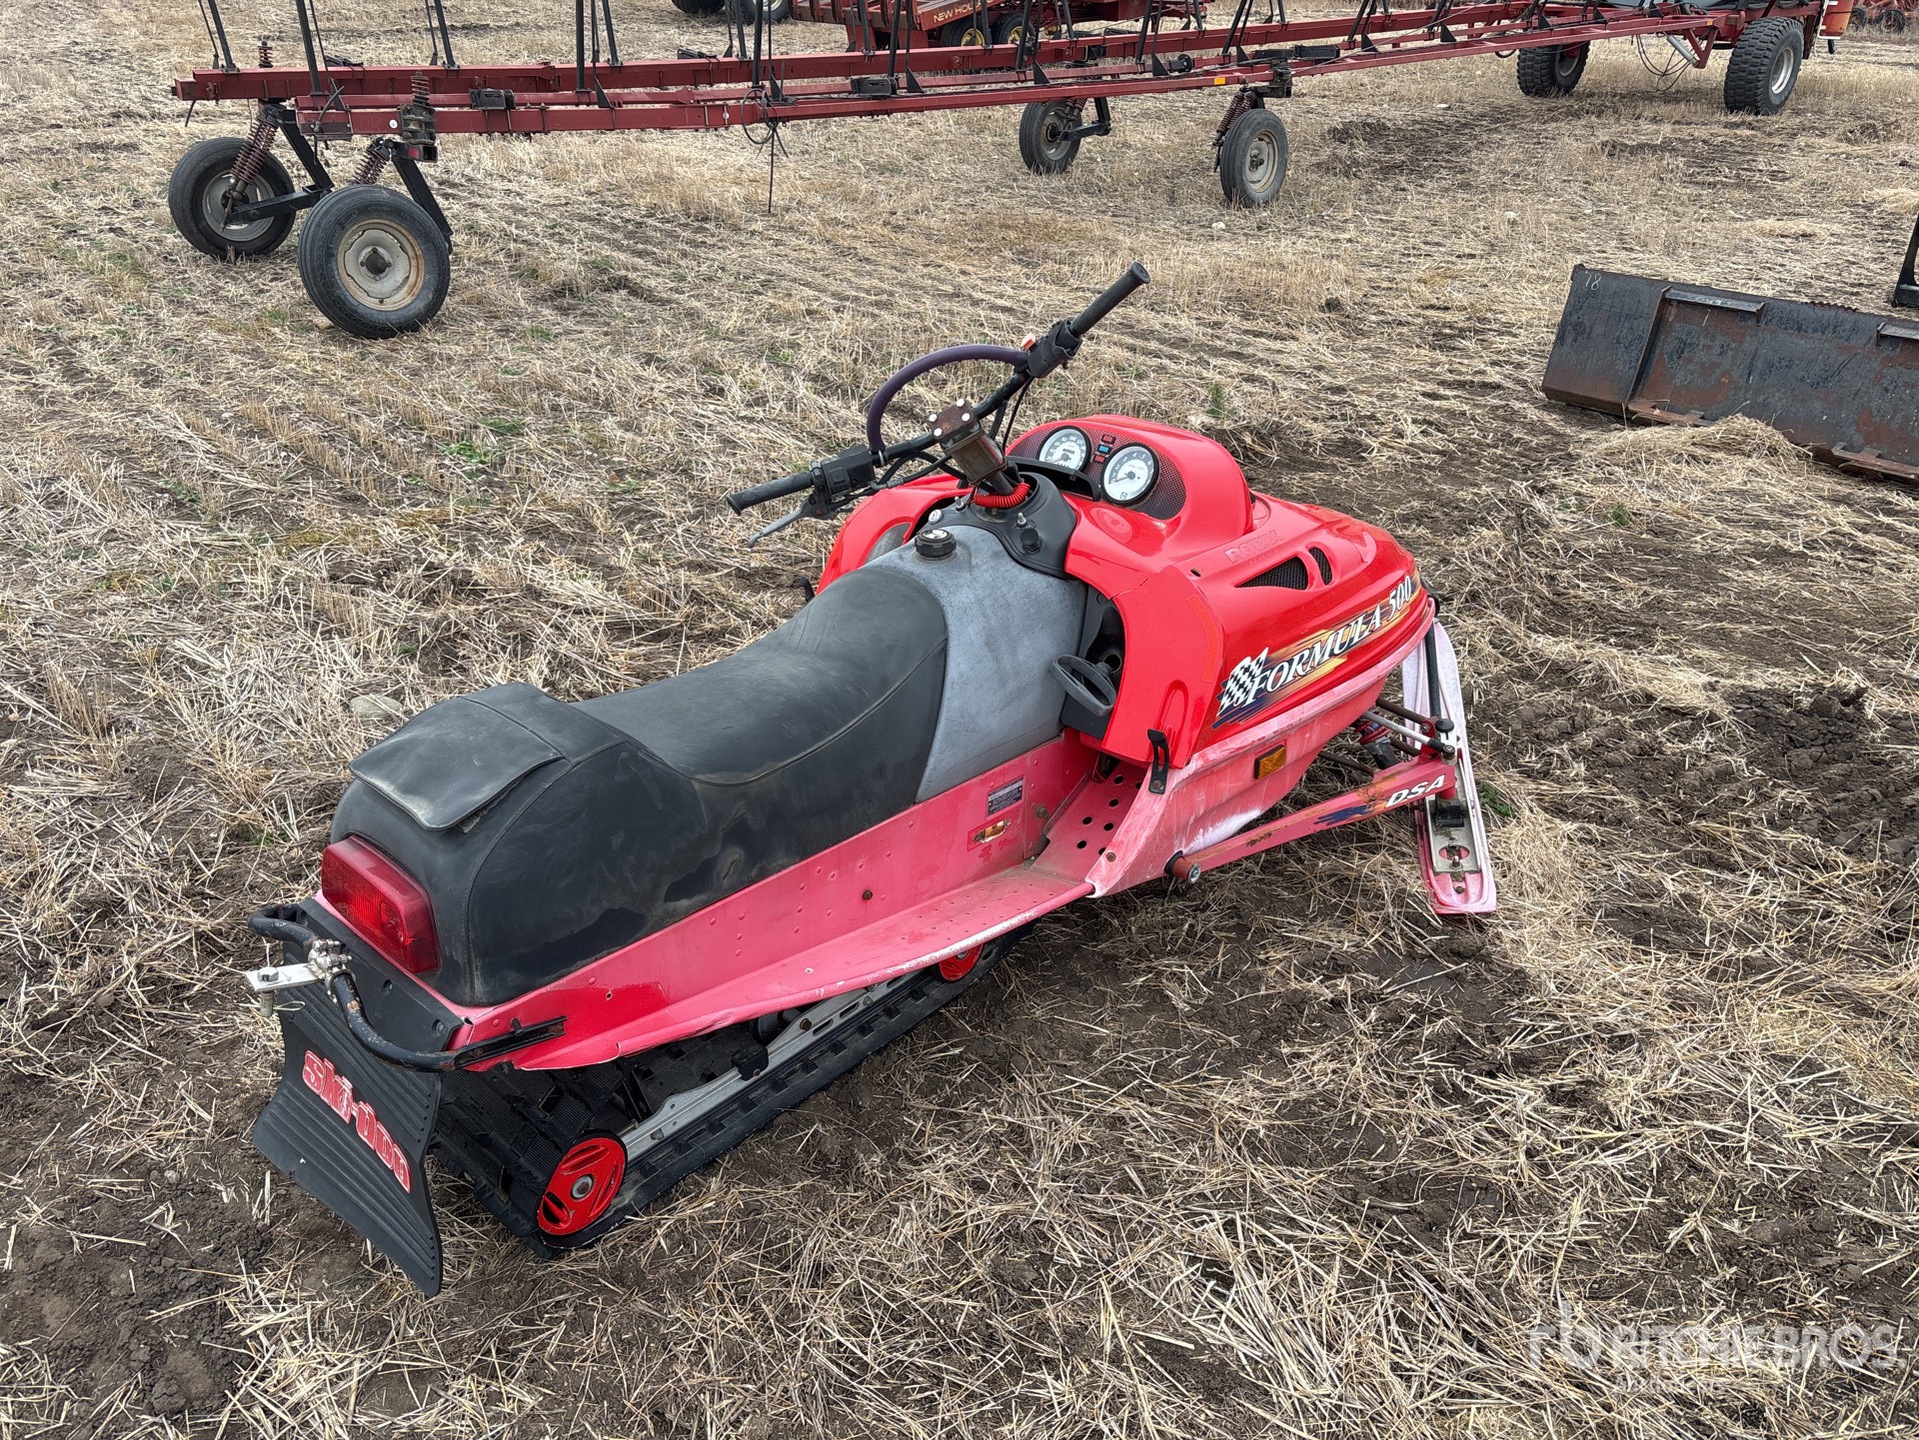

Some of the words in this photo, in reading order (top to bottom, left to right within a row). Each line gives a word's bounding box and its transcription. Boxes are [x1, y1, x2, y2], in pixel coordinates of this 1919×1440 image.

[933, 9, 953, 23] NEW
[1242, 603, 1384, 708] FORMULA
[1387, 574, 1412, 623] 500
[1385, 773, 1446, 809] DSA
